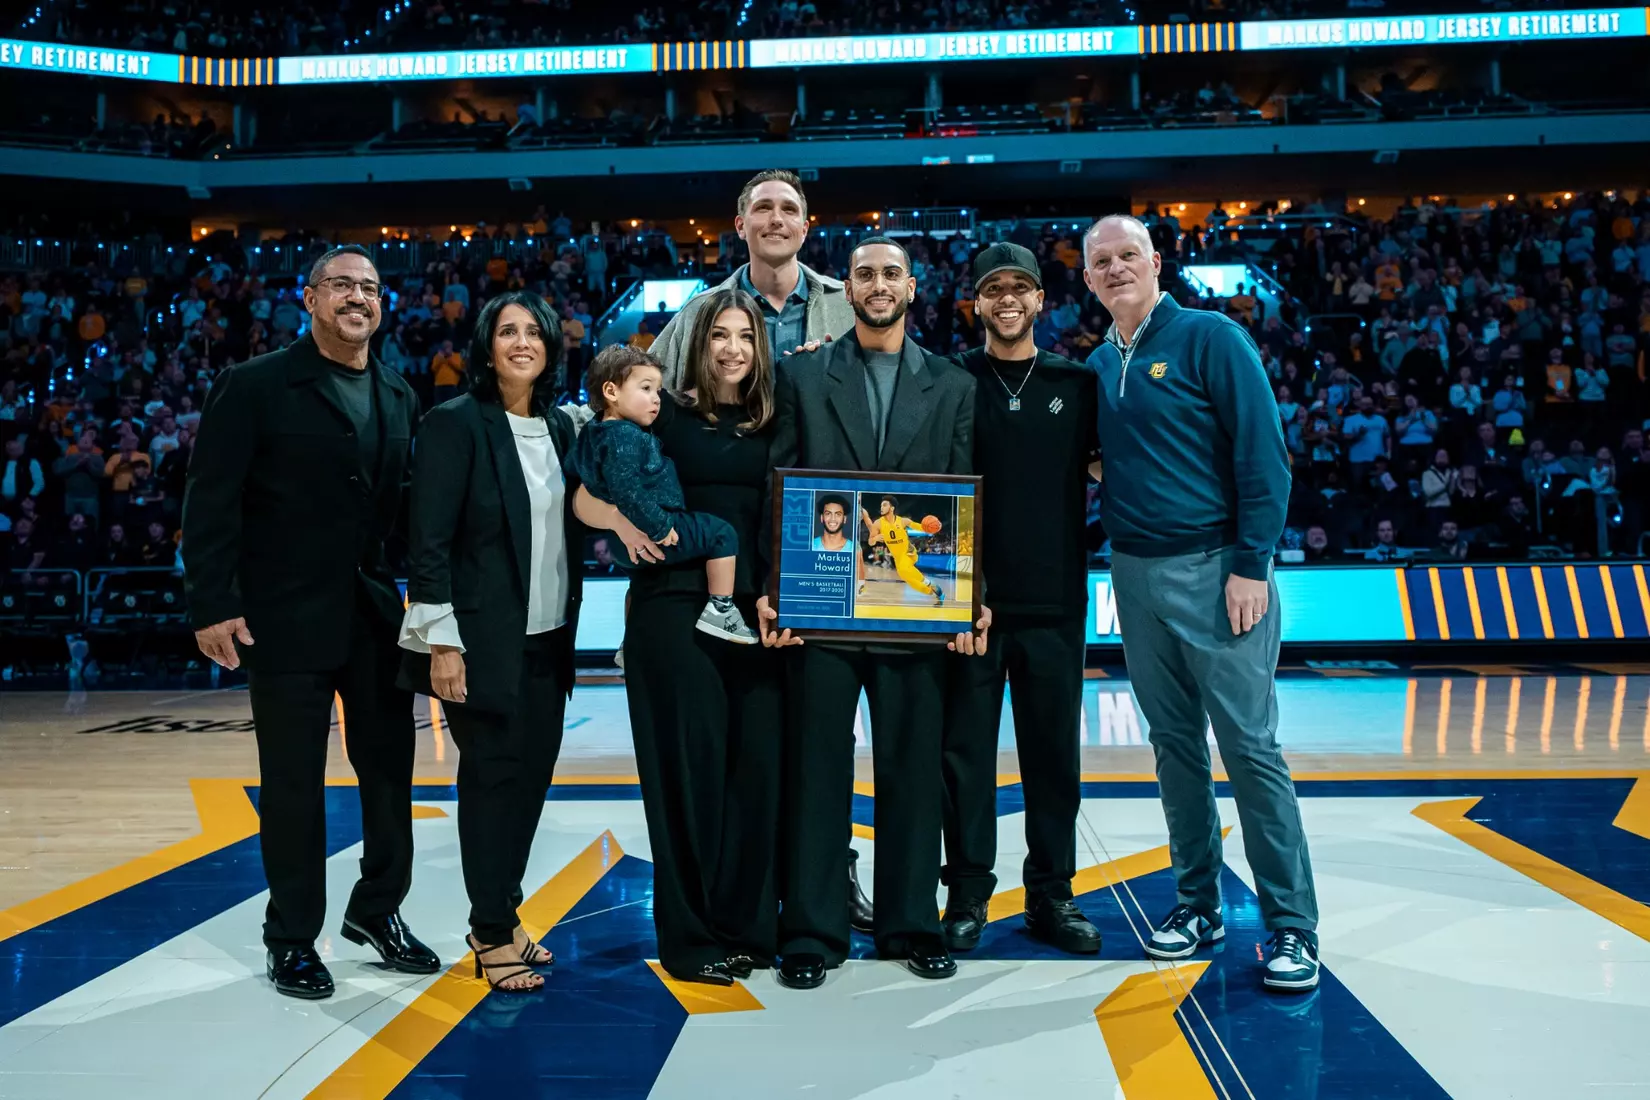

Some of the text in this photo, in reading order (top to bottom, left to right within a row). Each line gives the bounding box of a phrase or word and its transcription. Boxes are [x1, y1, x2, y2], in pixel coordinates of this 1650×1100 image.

[1267, 12, 1620, 46] MARKUS HOWARD JERSEY RETIREMENT
[939, 34, 1000, 57] JERSEY
[1006, 30, 1114, 54] RETIREMENT
[31, 46, 150, 75] RETIREMENT
[302, 48, 627, 80] MARKUS HOWARD JERSEY RETIREMENT
[814, 562, 850, 572] Howard
[817, 553, 851, 562] Markus
